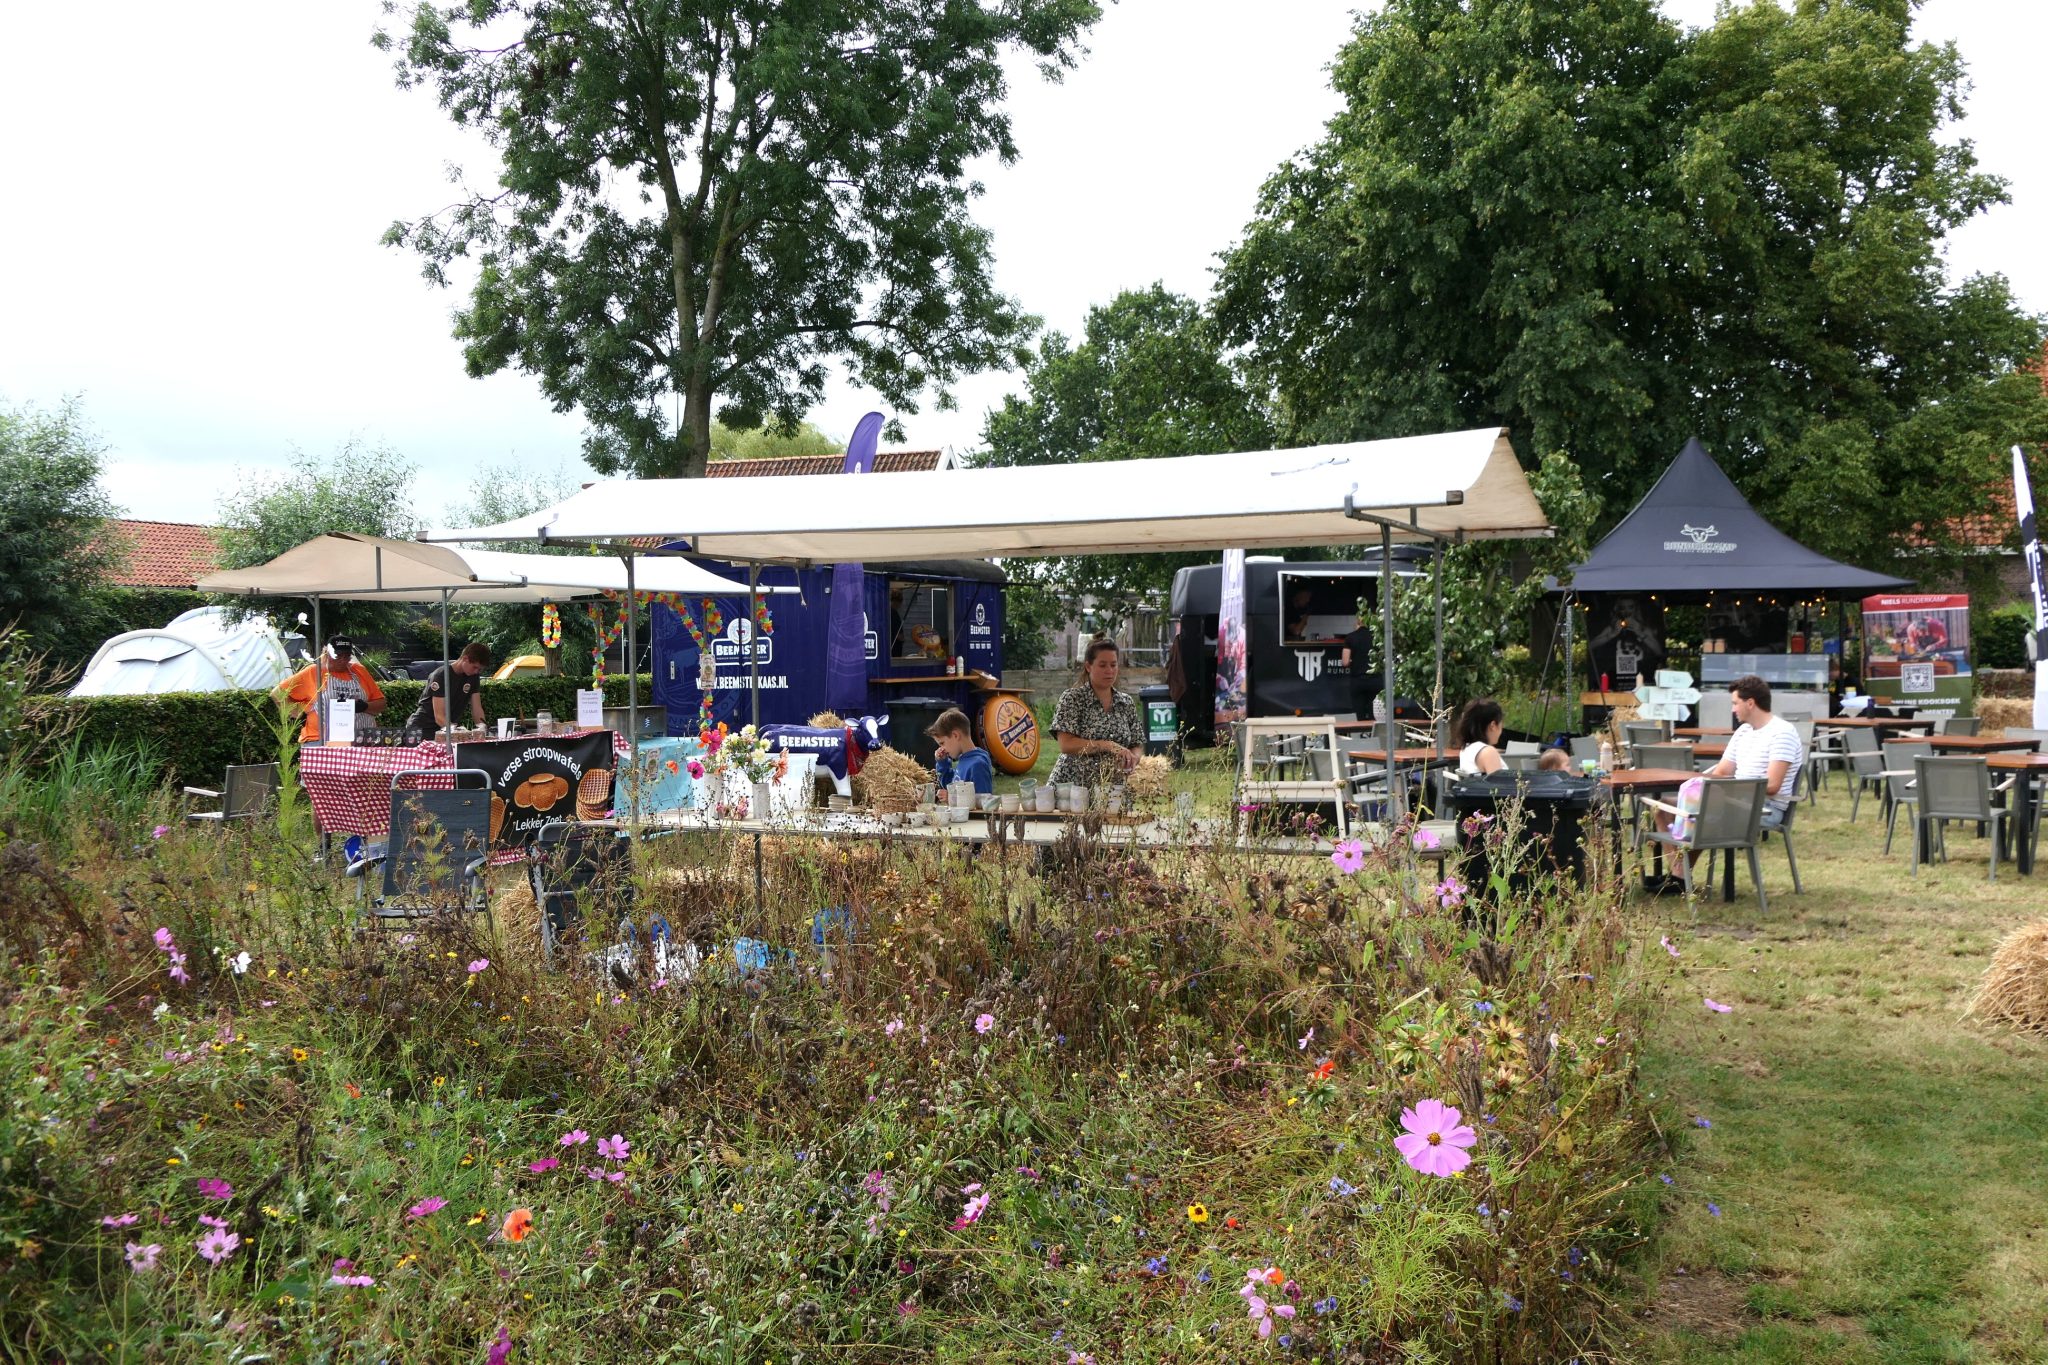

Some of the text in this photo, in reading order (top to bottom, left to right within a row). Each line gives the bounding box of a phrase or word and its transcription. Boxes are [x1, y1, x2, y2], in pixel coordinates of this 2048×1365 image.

[779, 735, 838, 747] BEEMSTER
[498, 747, 582, 788] verse stroopwafels
[515, 818, 544, 831] Lekker
